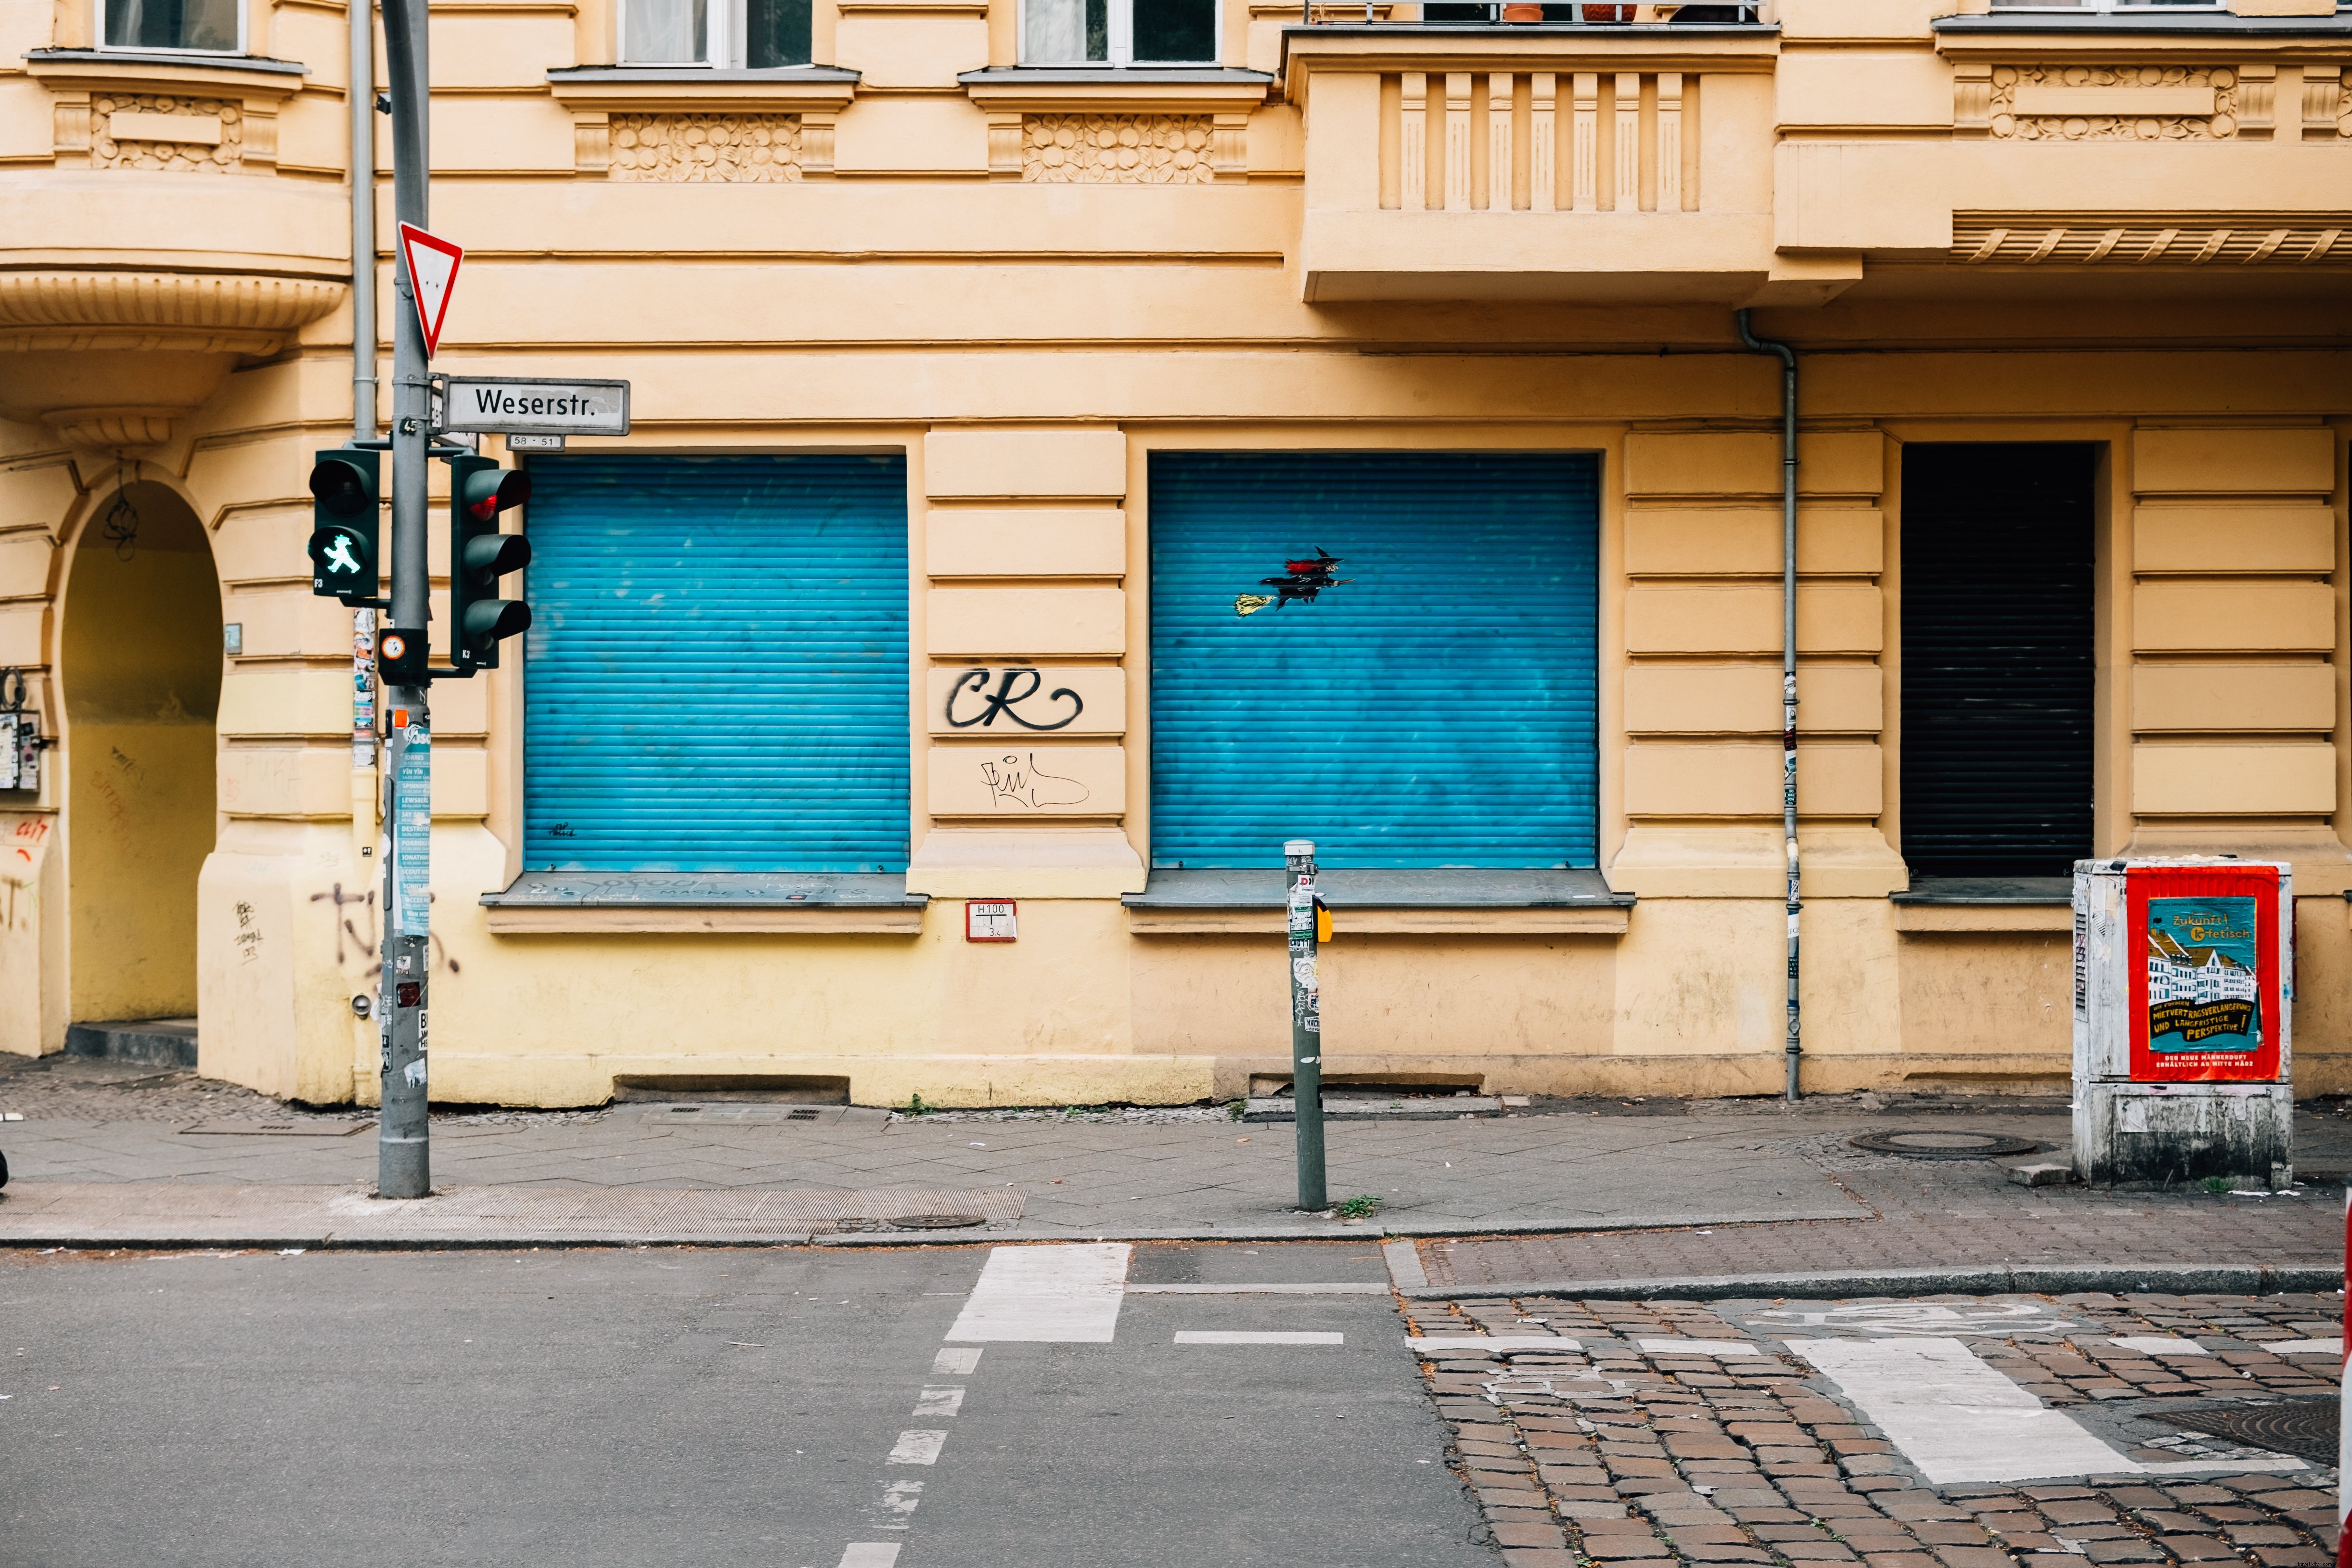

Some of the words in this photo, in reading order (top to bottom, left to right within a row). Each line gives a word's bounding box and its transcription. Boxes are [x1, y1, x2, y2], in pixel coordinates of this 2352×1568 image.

[476, 389, 595, 416] Weserstr.
[514, 437, 527, 445] 58
[541, 437, 553, 446] 51
[463, 649, 470, 658] K3
[2154, 1021, 2170, 1033] UND
[2175, 1015, 2229, 1027] LANGFRISTIGE
